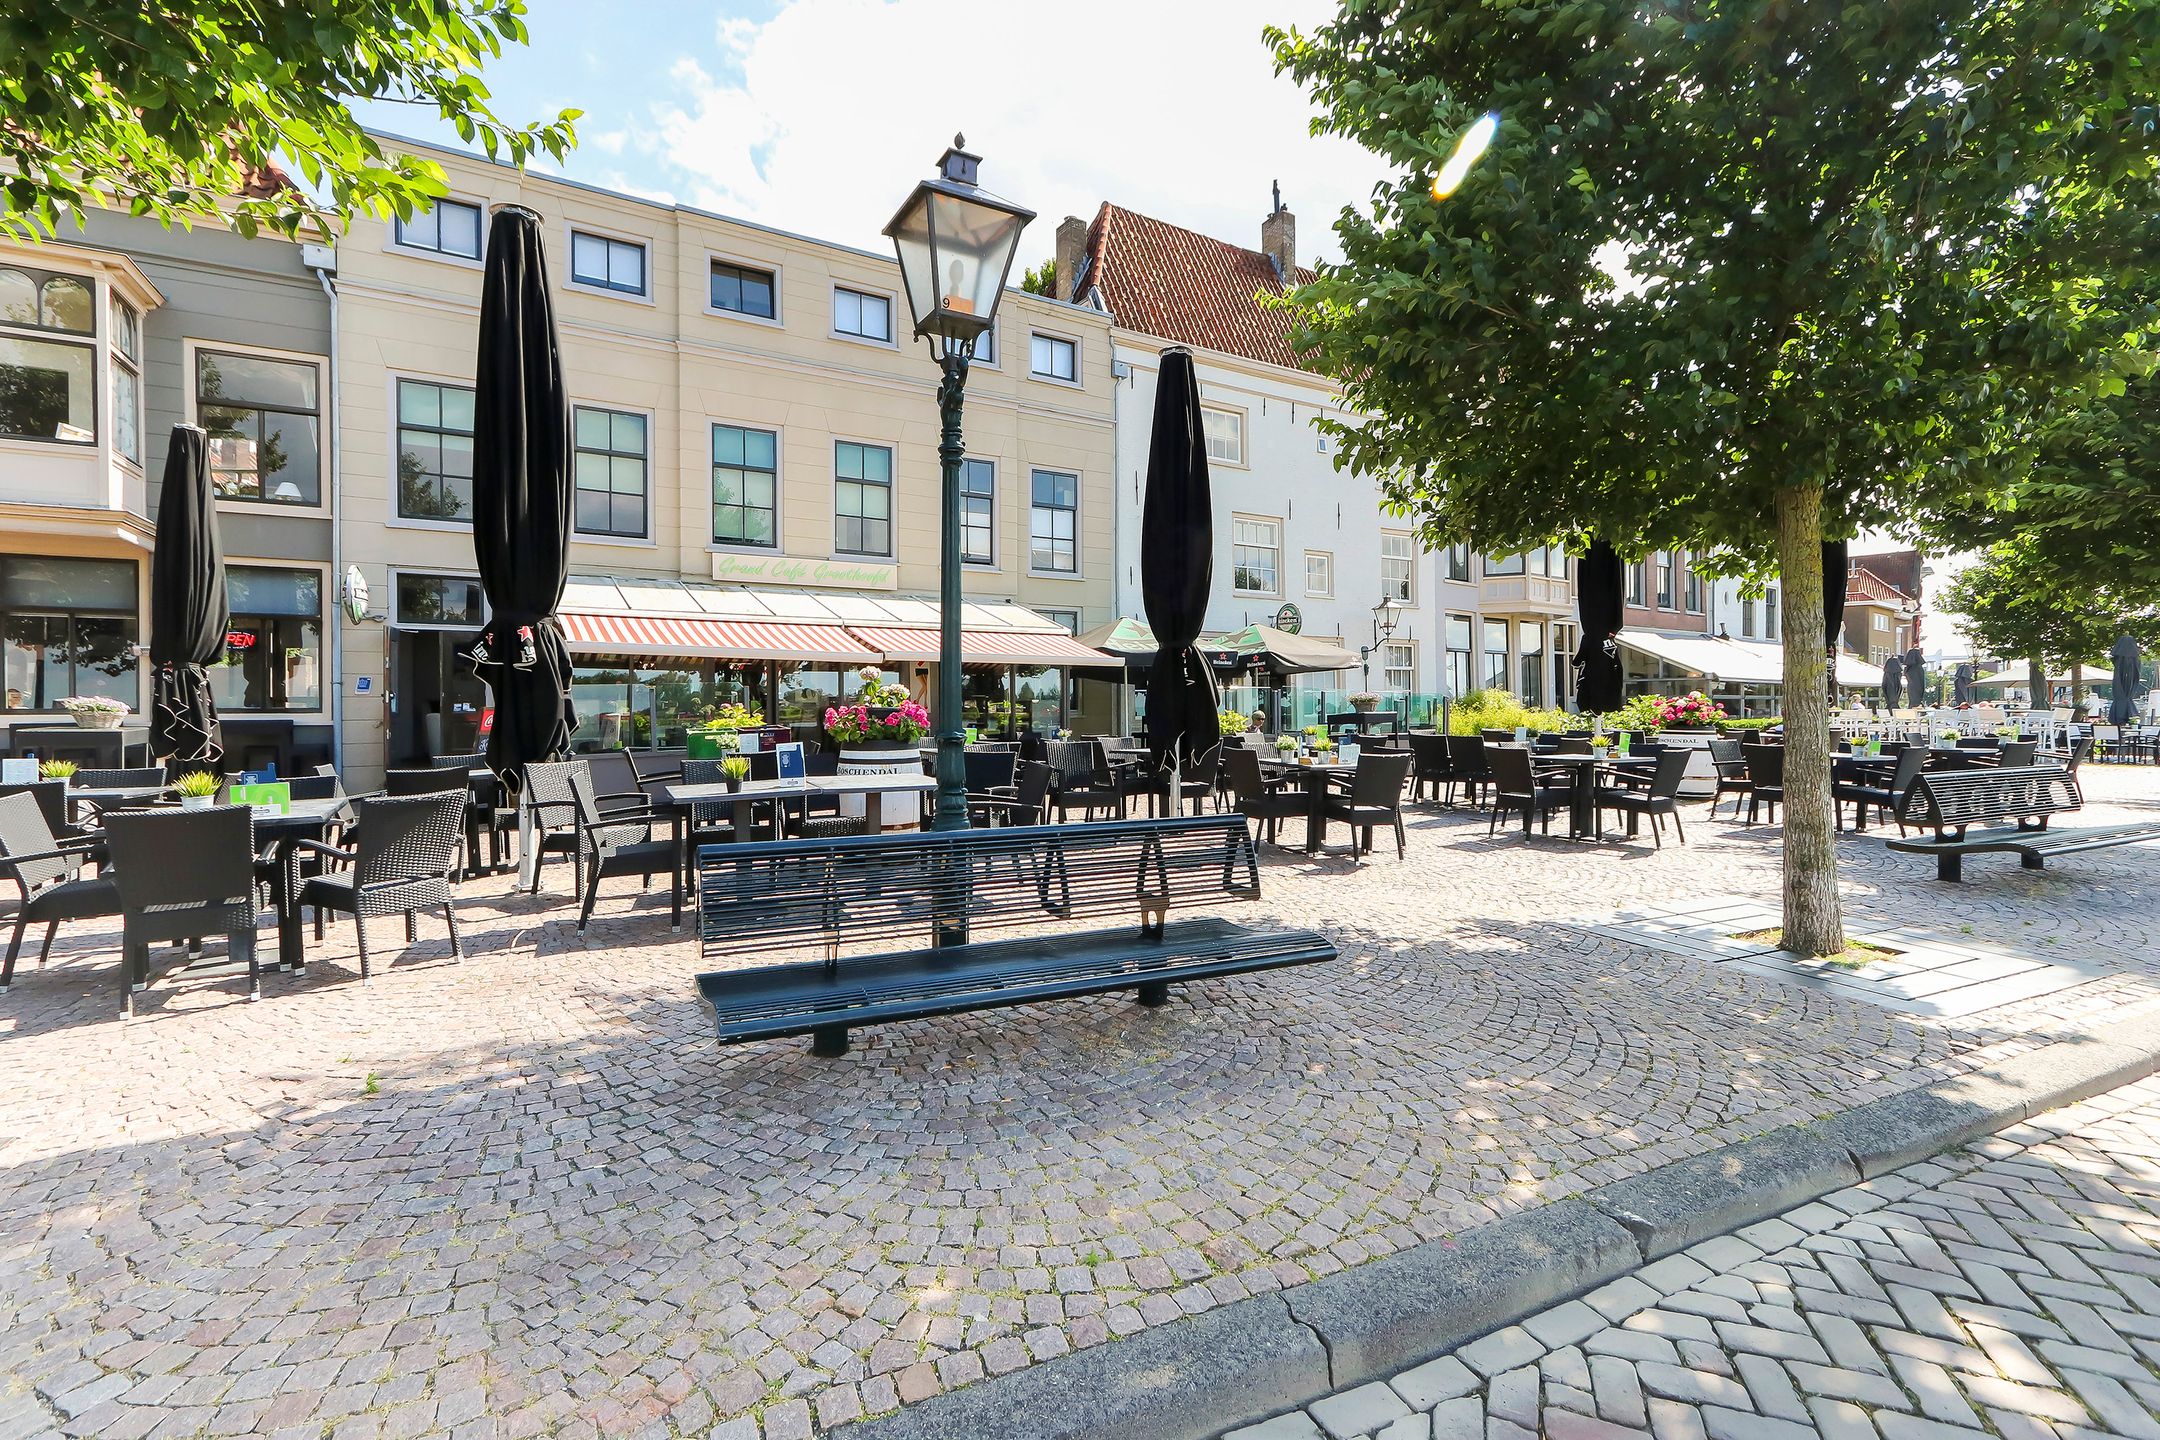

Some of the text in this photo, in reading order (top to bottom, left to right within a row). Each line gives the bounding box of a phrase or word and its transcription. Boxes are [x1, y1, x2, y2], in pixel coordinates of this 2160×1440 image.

[719, 556, 769, 575] Grand
[771, 559, 810, 582] Café
[226, 634, 256, 646] PEN
